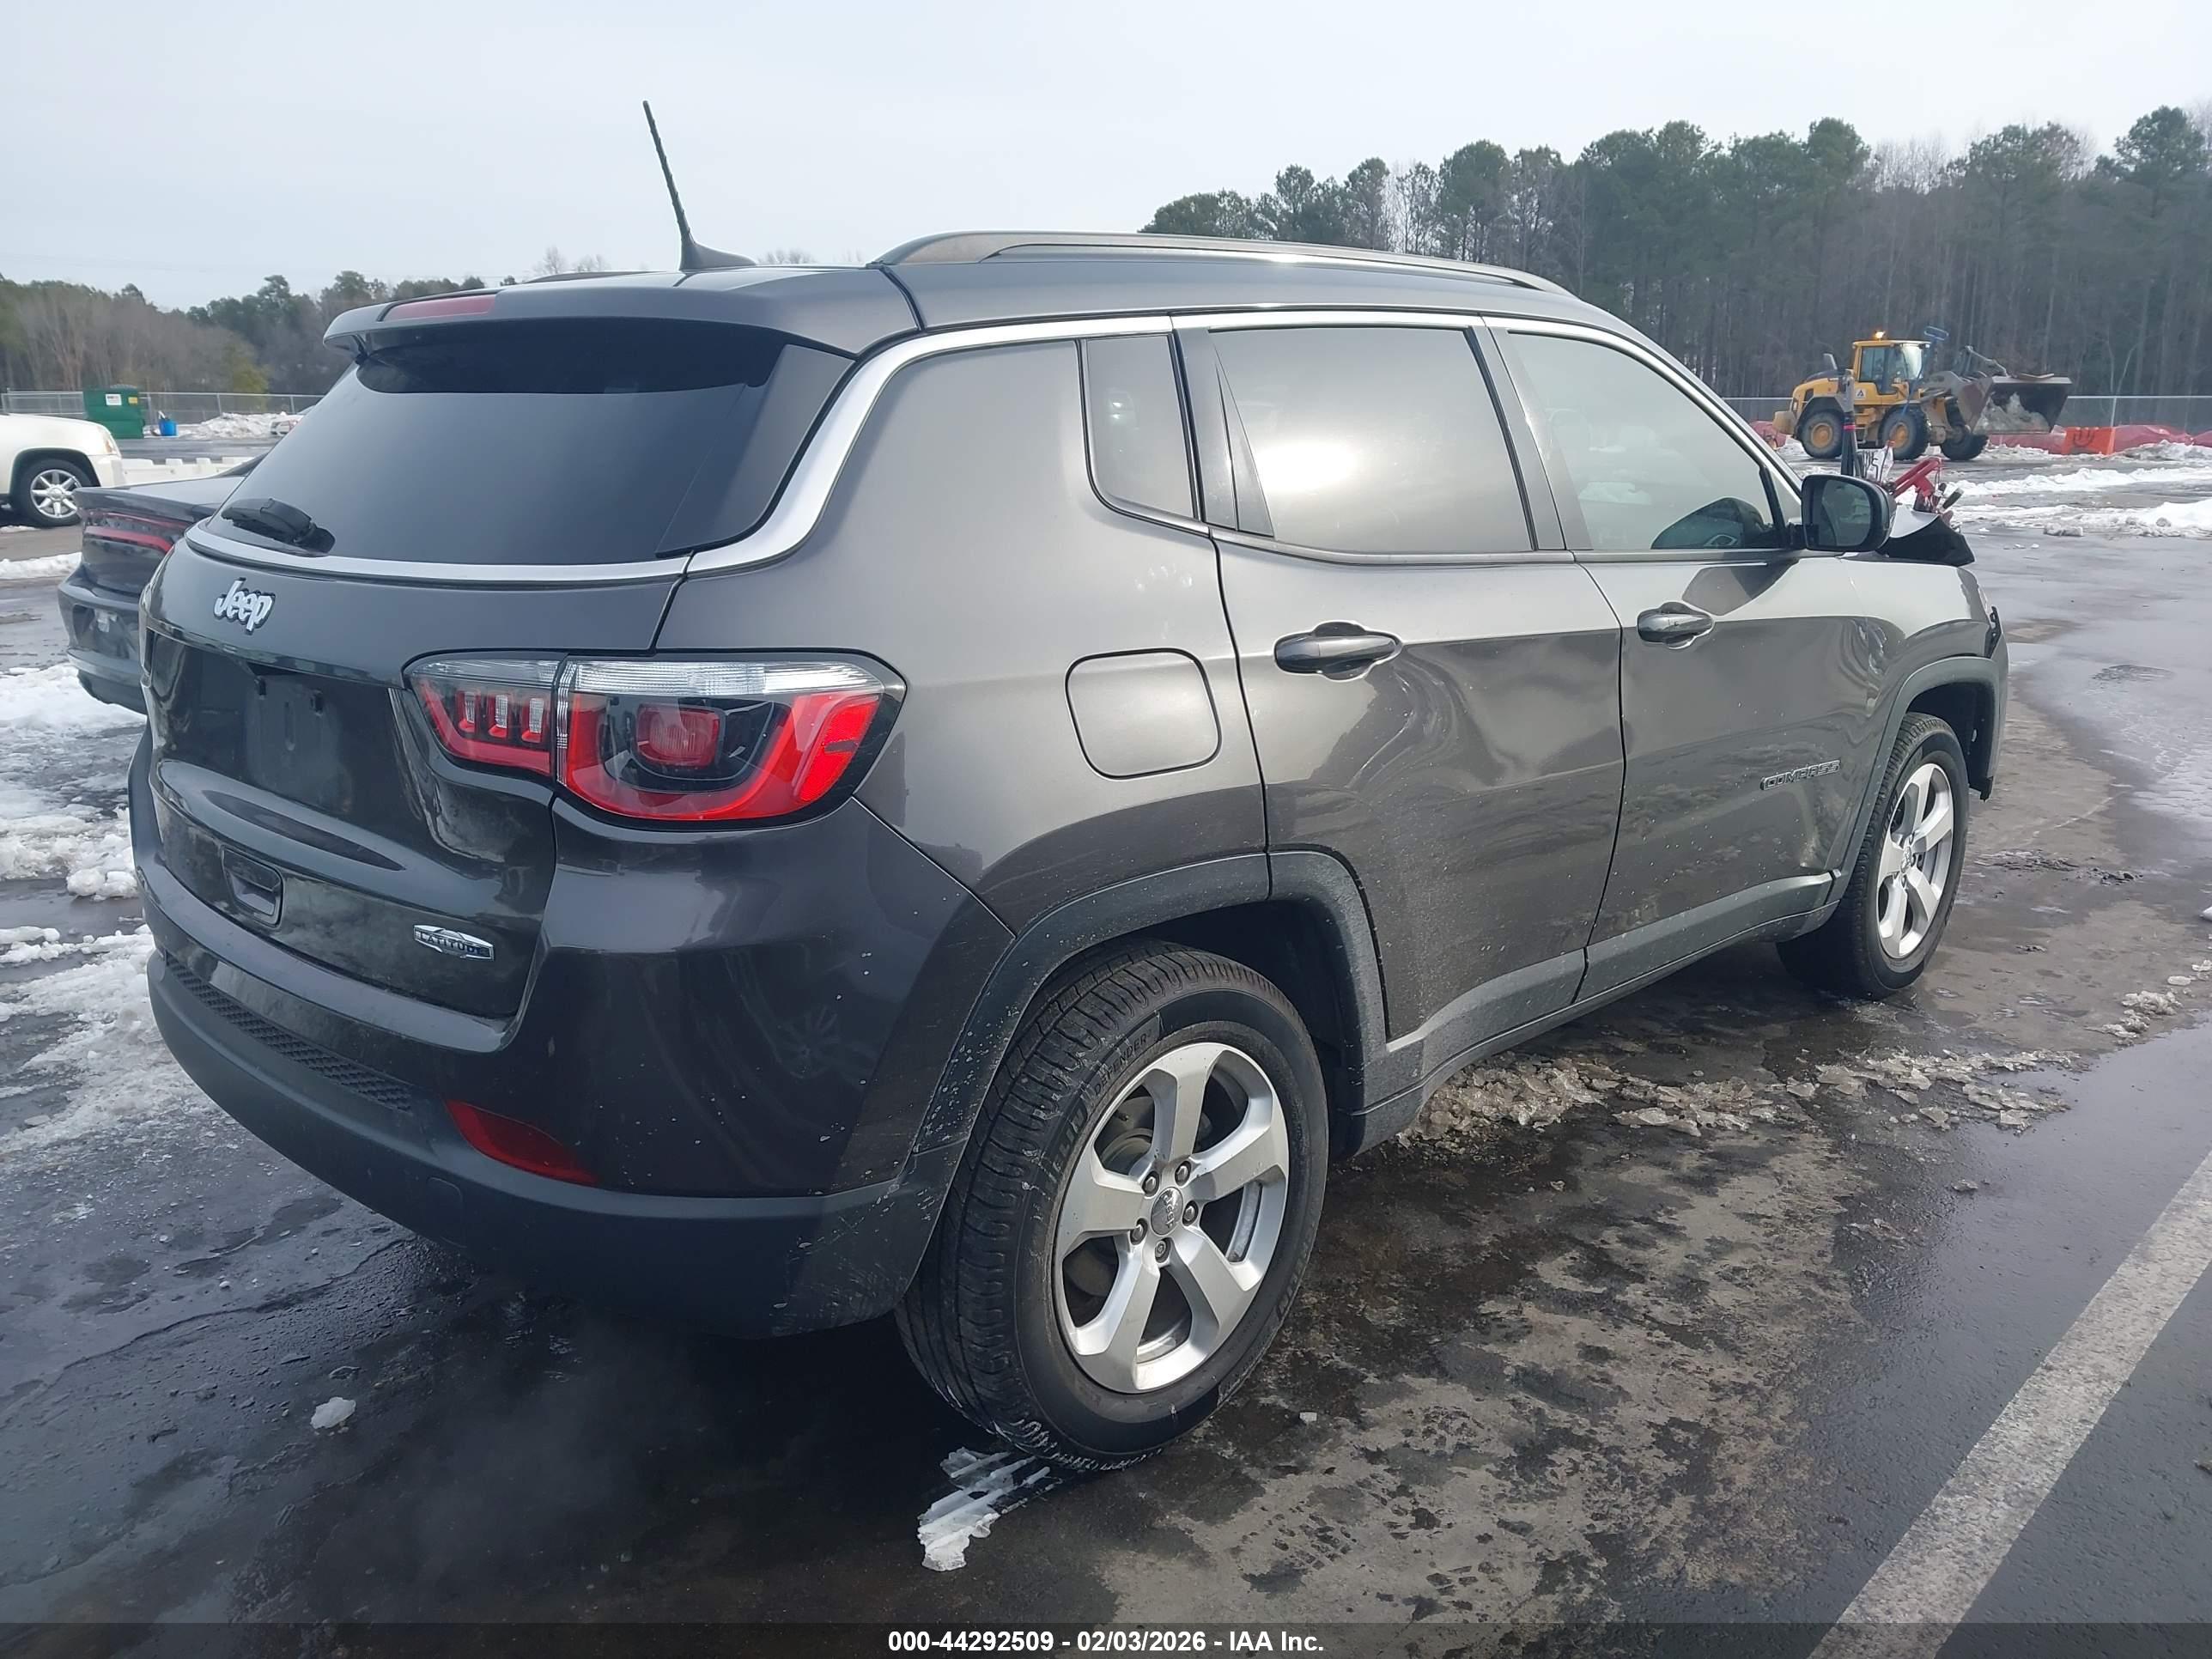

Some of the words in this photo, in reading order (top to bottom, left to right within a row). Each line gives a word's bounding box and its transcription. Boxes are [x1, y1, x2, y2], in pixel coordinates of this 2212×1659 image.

[214, 579, 275, 633] Jeep
[1760, 760, 1841, 790] COMPASS
[418, 930, 490, 957] LATITUDE
